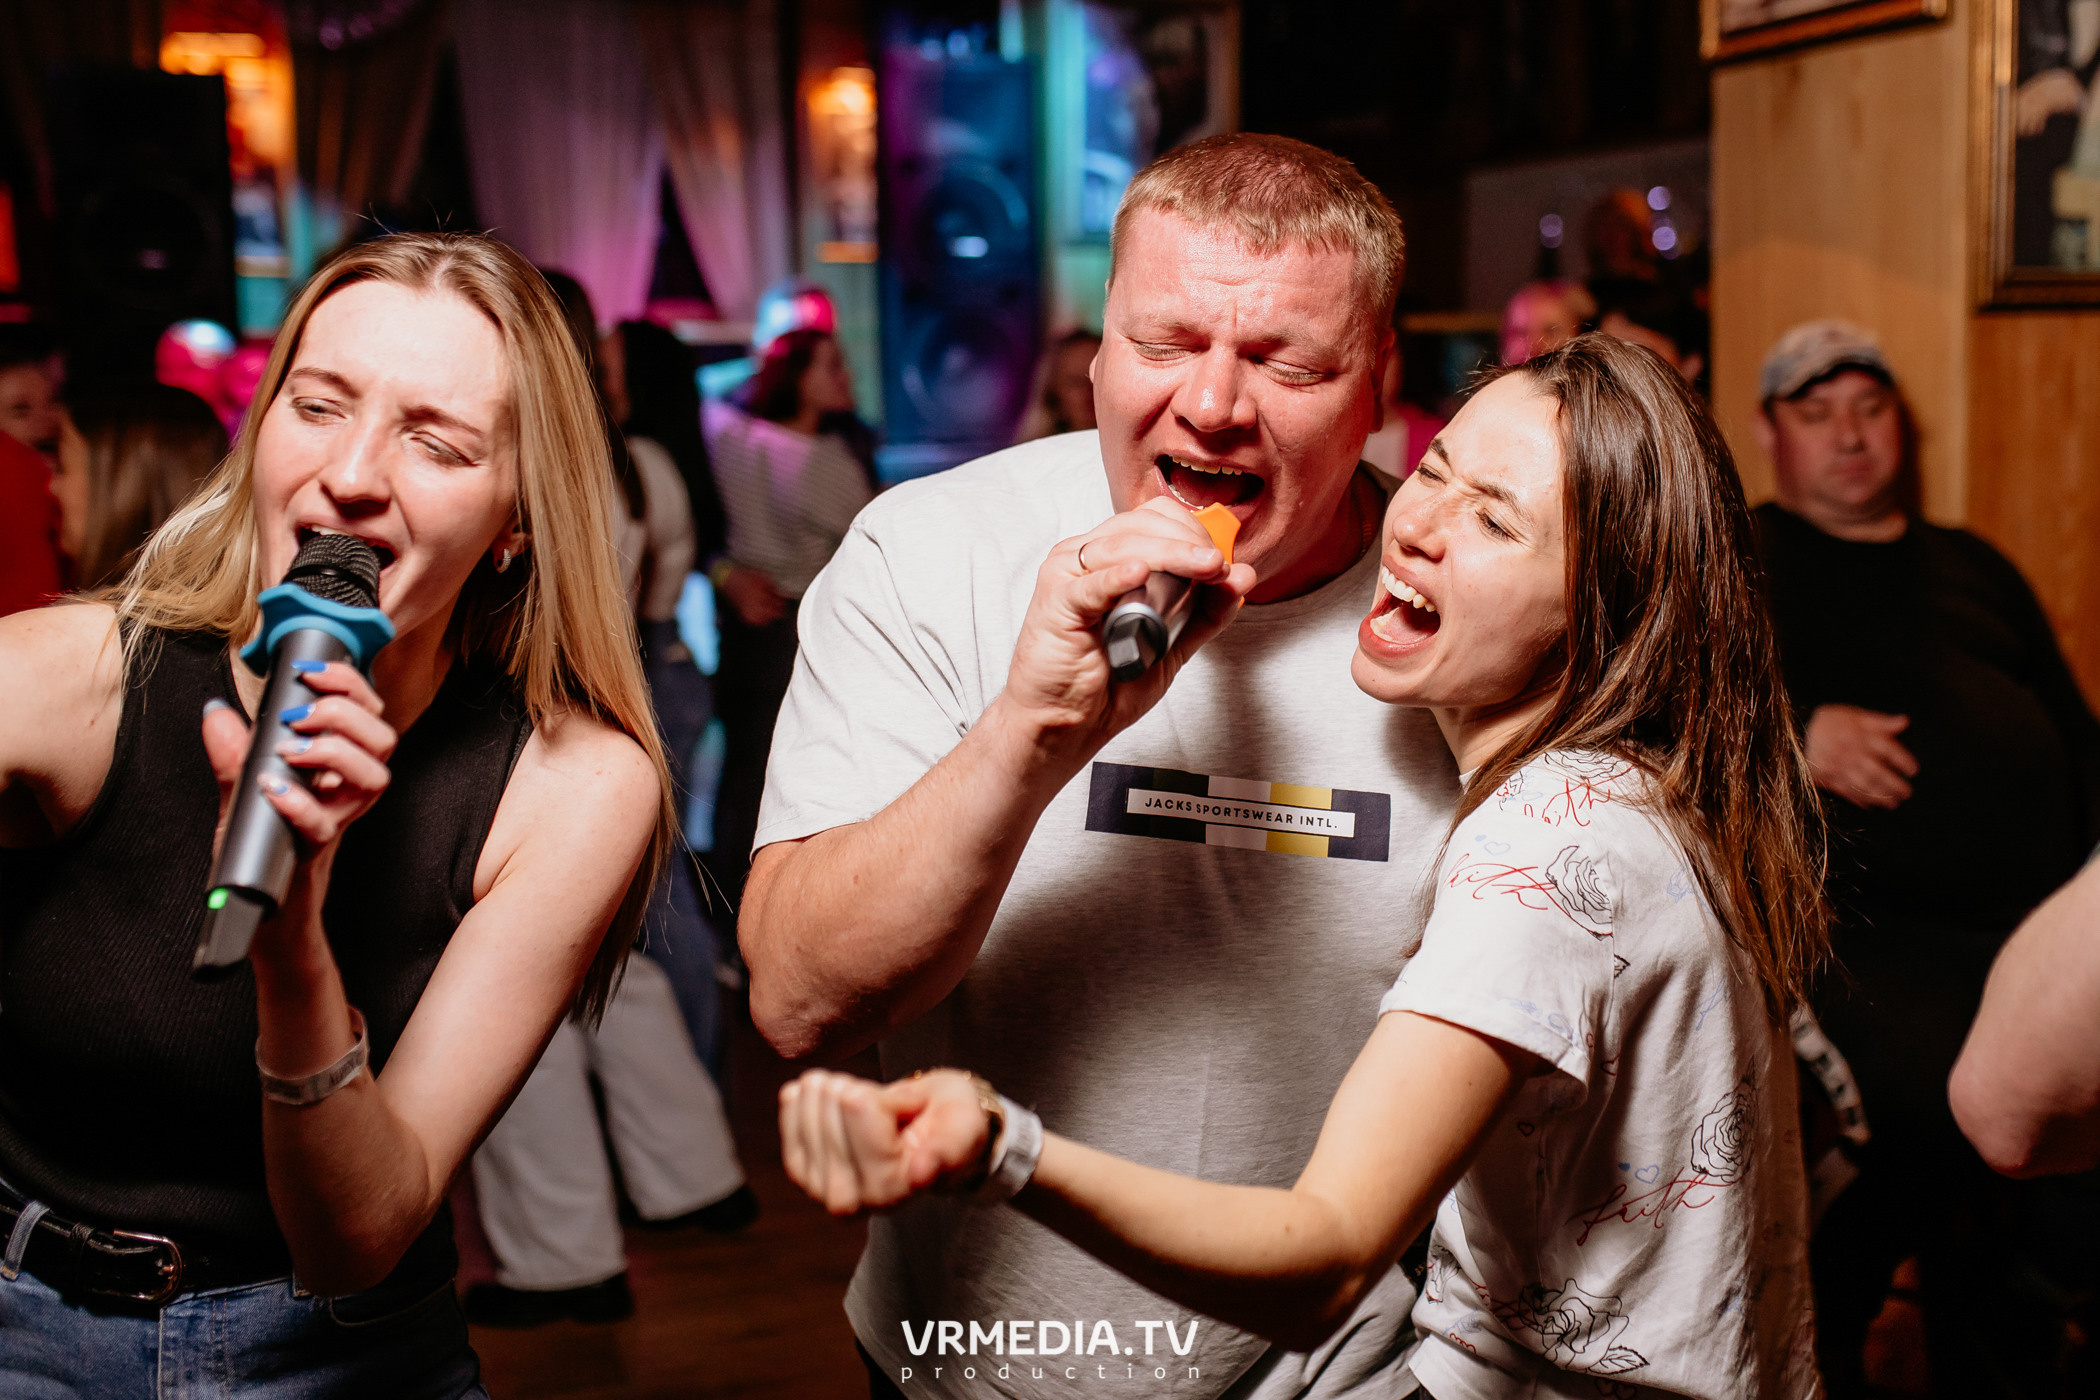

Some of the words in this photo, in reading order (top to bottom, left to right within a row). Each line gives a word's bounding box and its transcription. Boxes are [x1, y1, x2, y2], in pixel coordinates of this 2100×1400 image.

[1145, 797, 1192, 812] JACKS
[1196, 803, 1294, 824] SPORTSWEAR
[1300, 815, 1338, 829] INTL.
